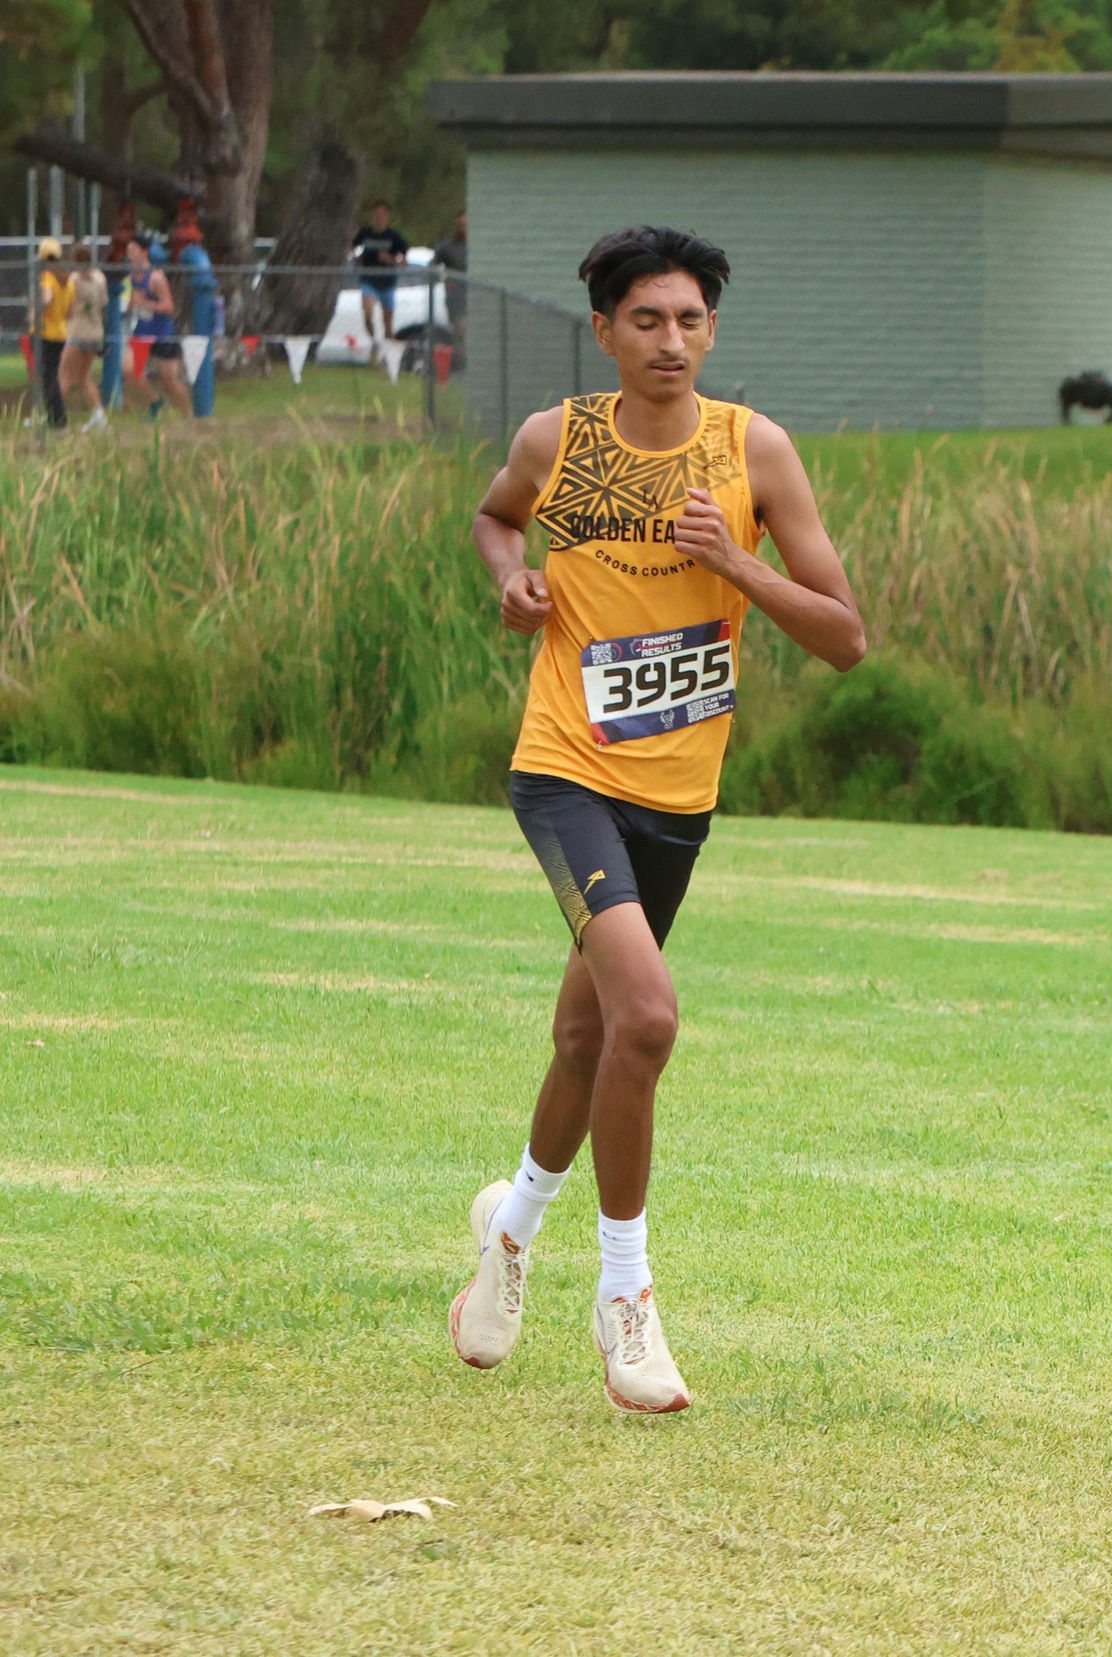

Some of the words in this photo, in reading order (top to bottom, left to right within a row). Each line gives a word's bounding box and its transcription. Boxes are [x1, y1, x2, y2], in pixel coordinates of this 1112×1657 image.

[571, 514, 646, 542] GOLDEN
[595, 549, 638, 576] CROSS
[641, 559, 696, 577] COUNTR
[641, 643, 682, 658] RESULTS
[642, 632, 684, 648] FINISHED
[603, 644, 730, 714] 3955
